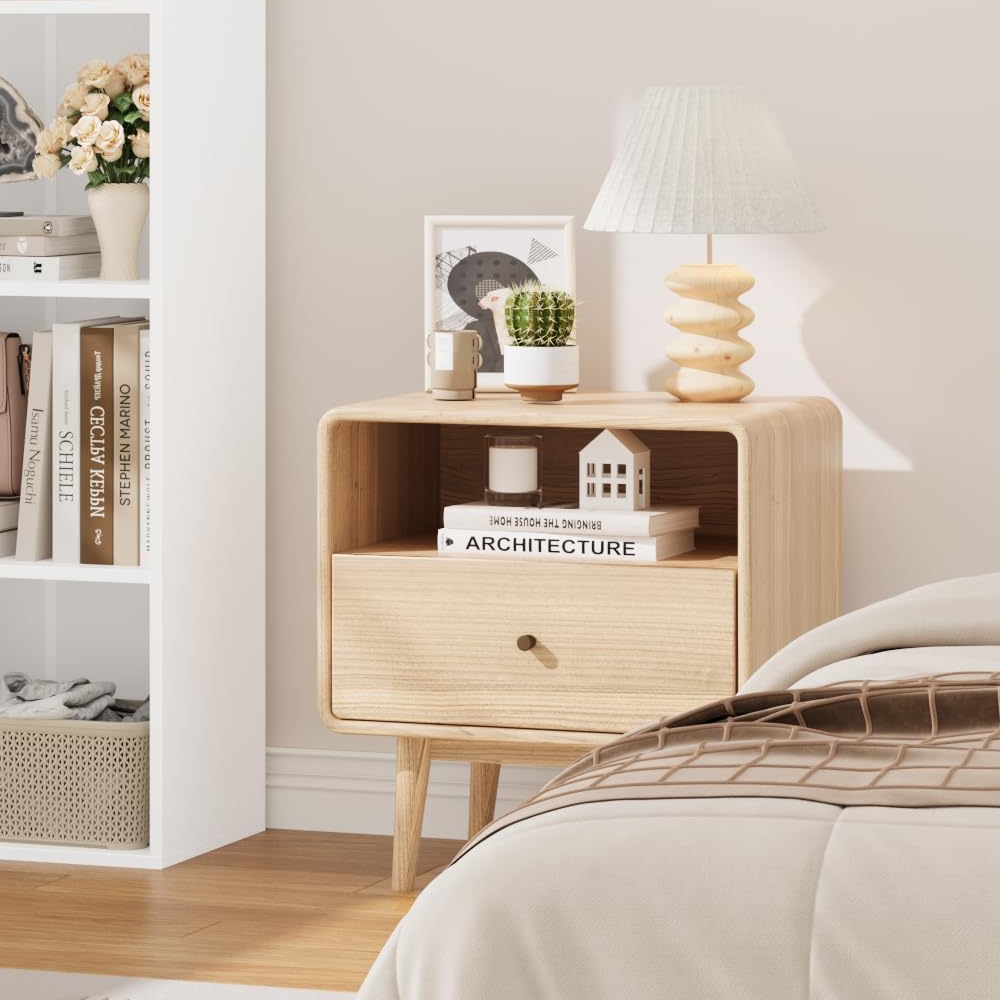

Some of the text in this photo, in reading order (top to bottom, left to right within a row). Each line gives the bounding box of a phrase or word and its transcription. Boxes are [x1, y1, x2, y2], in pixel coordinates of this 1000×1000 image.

[24, 408, 44, 504] Isamu Noguchi
[58, 431, 74, 502] SCHIELE
[120, 384, 131, 506] STEPHEN MARINO
[466, 536, 636, 556] ARCHITECTURE
[489, 515, 602, 530] BRINGING THE HOUSE HOME
